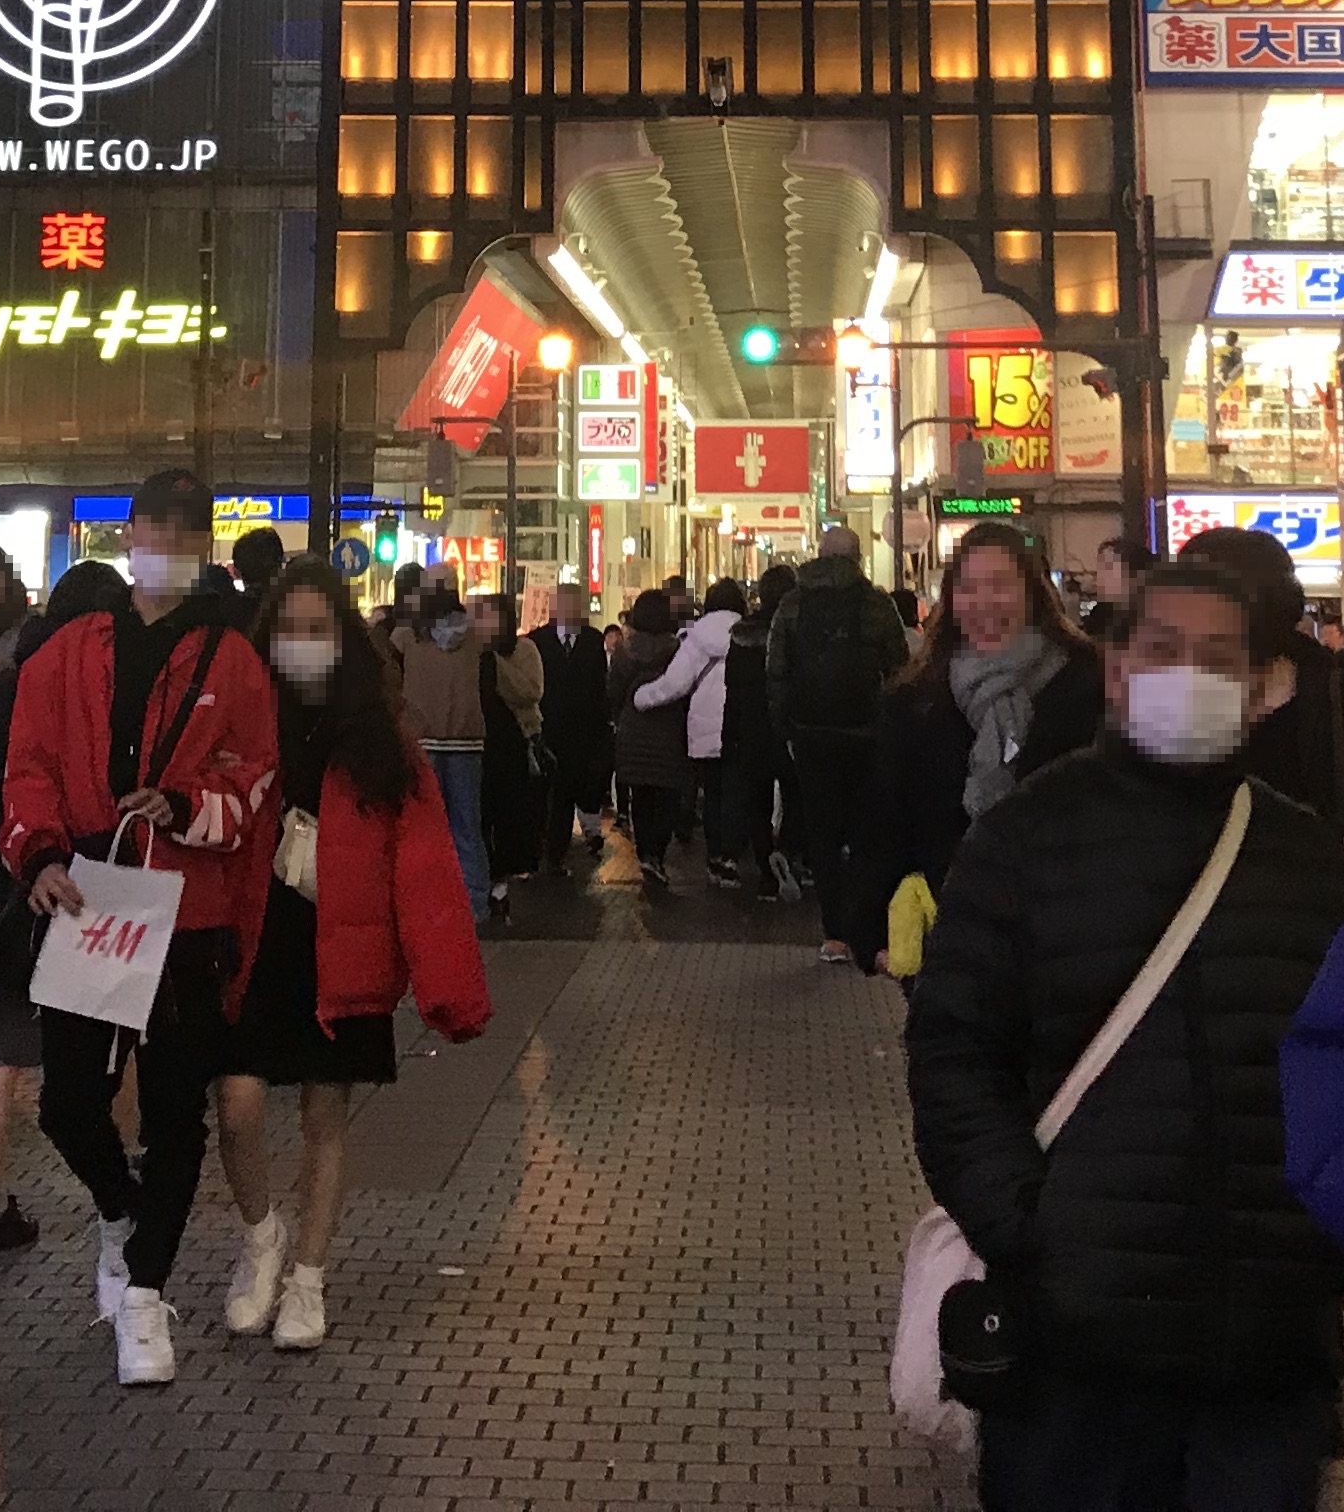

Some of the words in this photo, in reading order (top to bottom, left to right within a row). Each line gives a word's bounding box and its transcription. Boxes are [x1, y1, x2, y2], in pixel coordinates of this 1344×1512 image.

[1165, 17, 1217, 65] 薬
[40, 212, 107, 271] 薬
[1241, 256, 1286, 306] 薬
[1013, 436, 1050, 469] OFF
